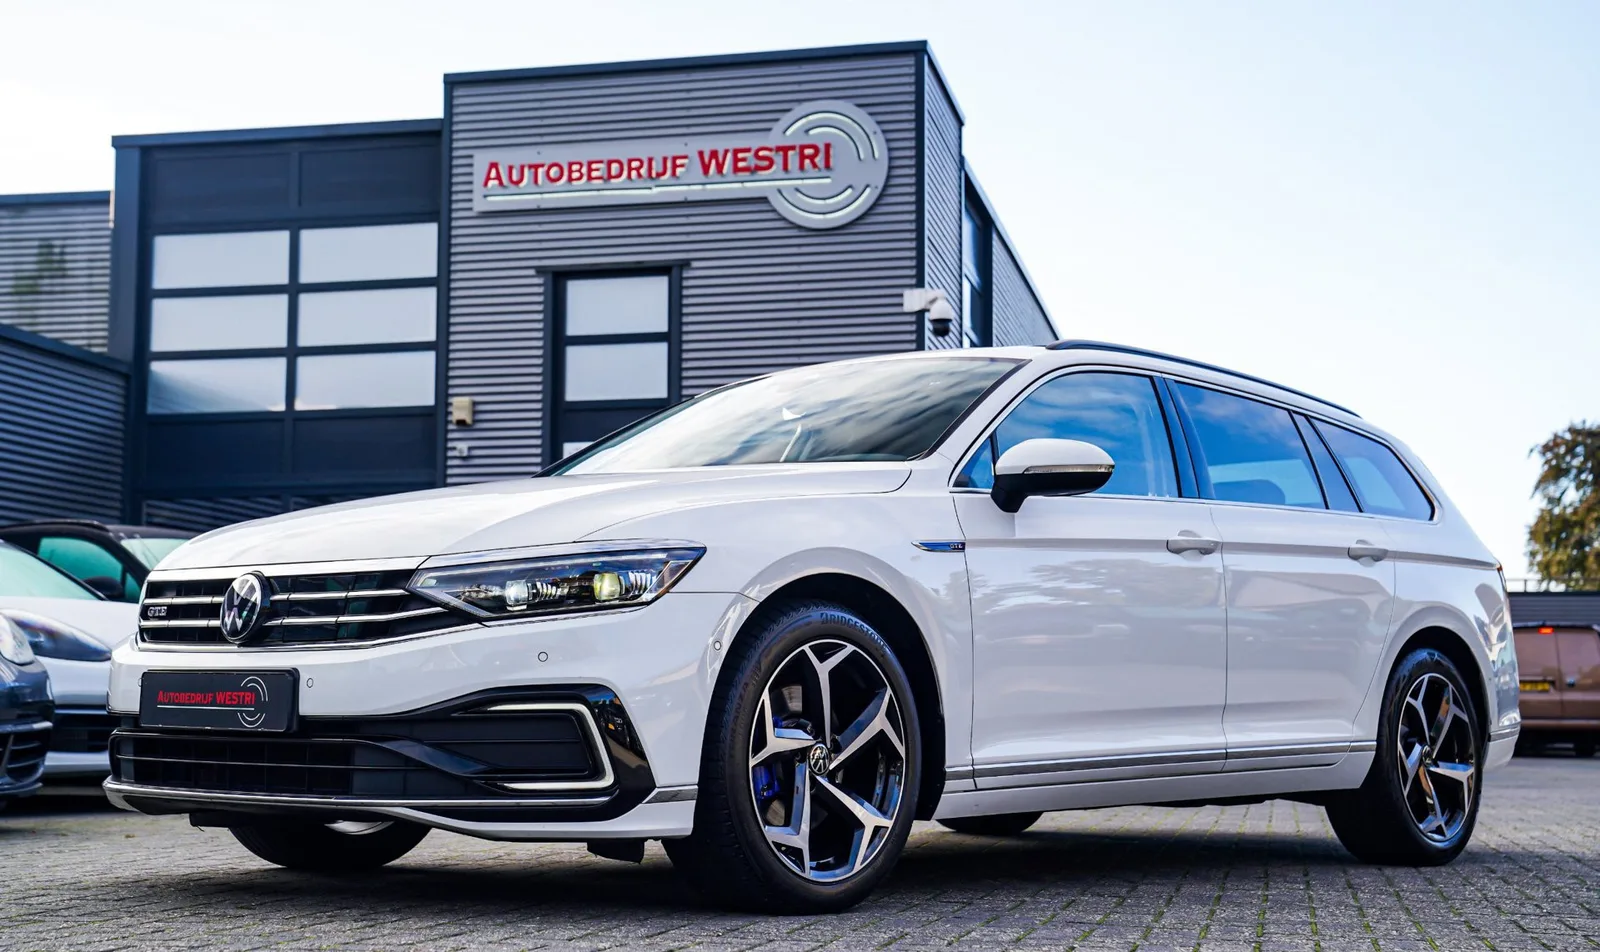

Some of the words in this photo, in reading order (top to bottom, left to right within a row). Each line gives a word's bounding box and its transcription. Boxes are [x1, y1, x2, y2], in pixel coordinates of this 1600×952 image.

[483, 154, 689, 188] AUTOBEDRIJF
[697, 142, 832, 175] WESTRI
[147, 606, 168, 617] GTE
[157, 690, 214, 704] AUTOBEDRIJF
[215, 691, 256, 705] WESTRI
